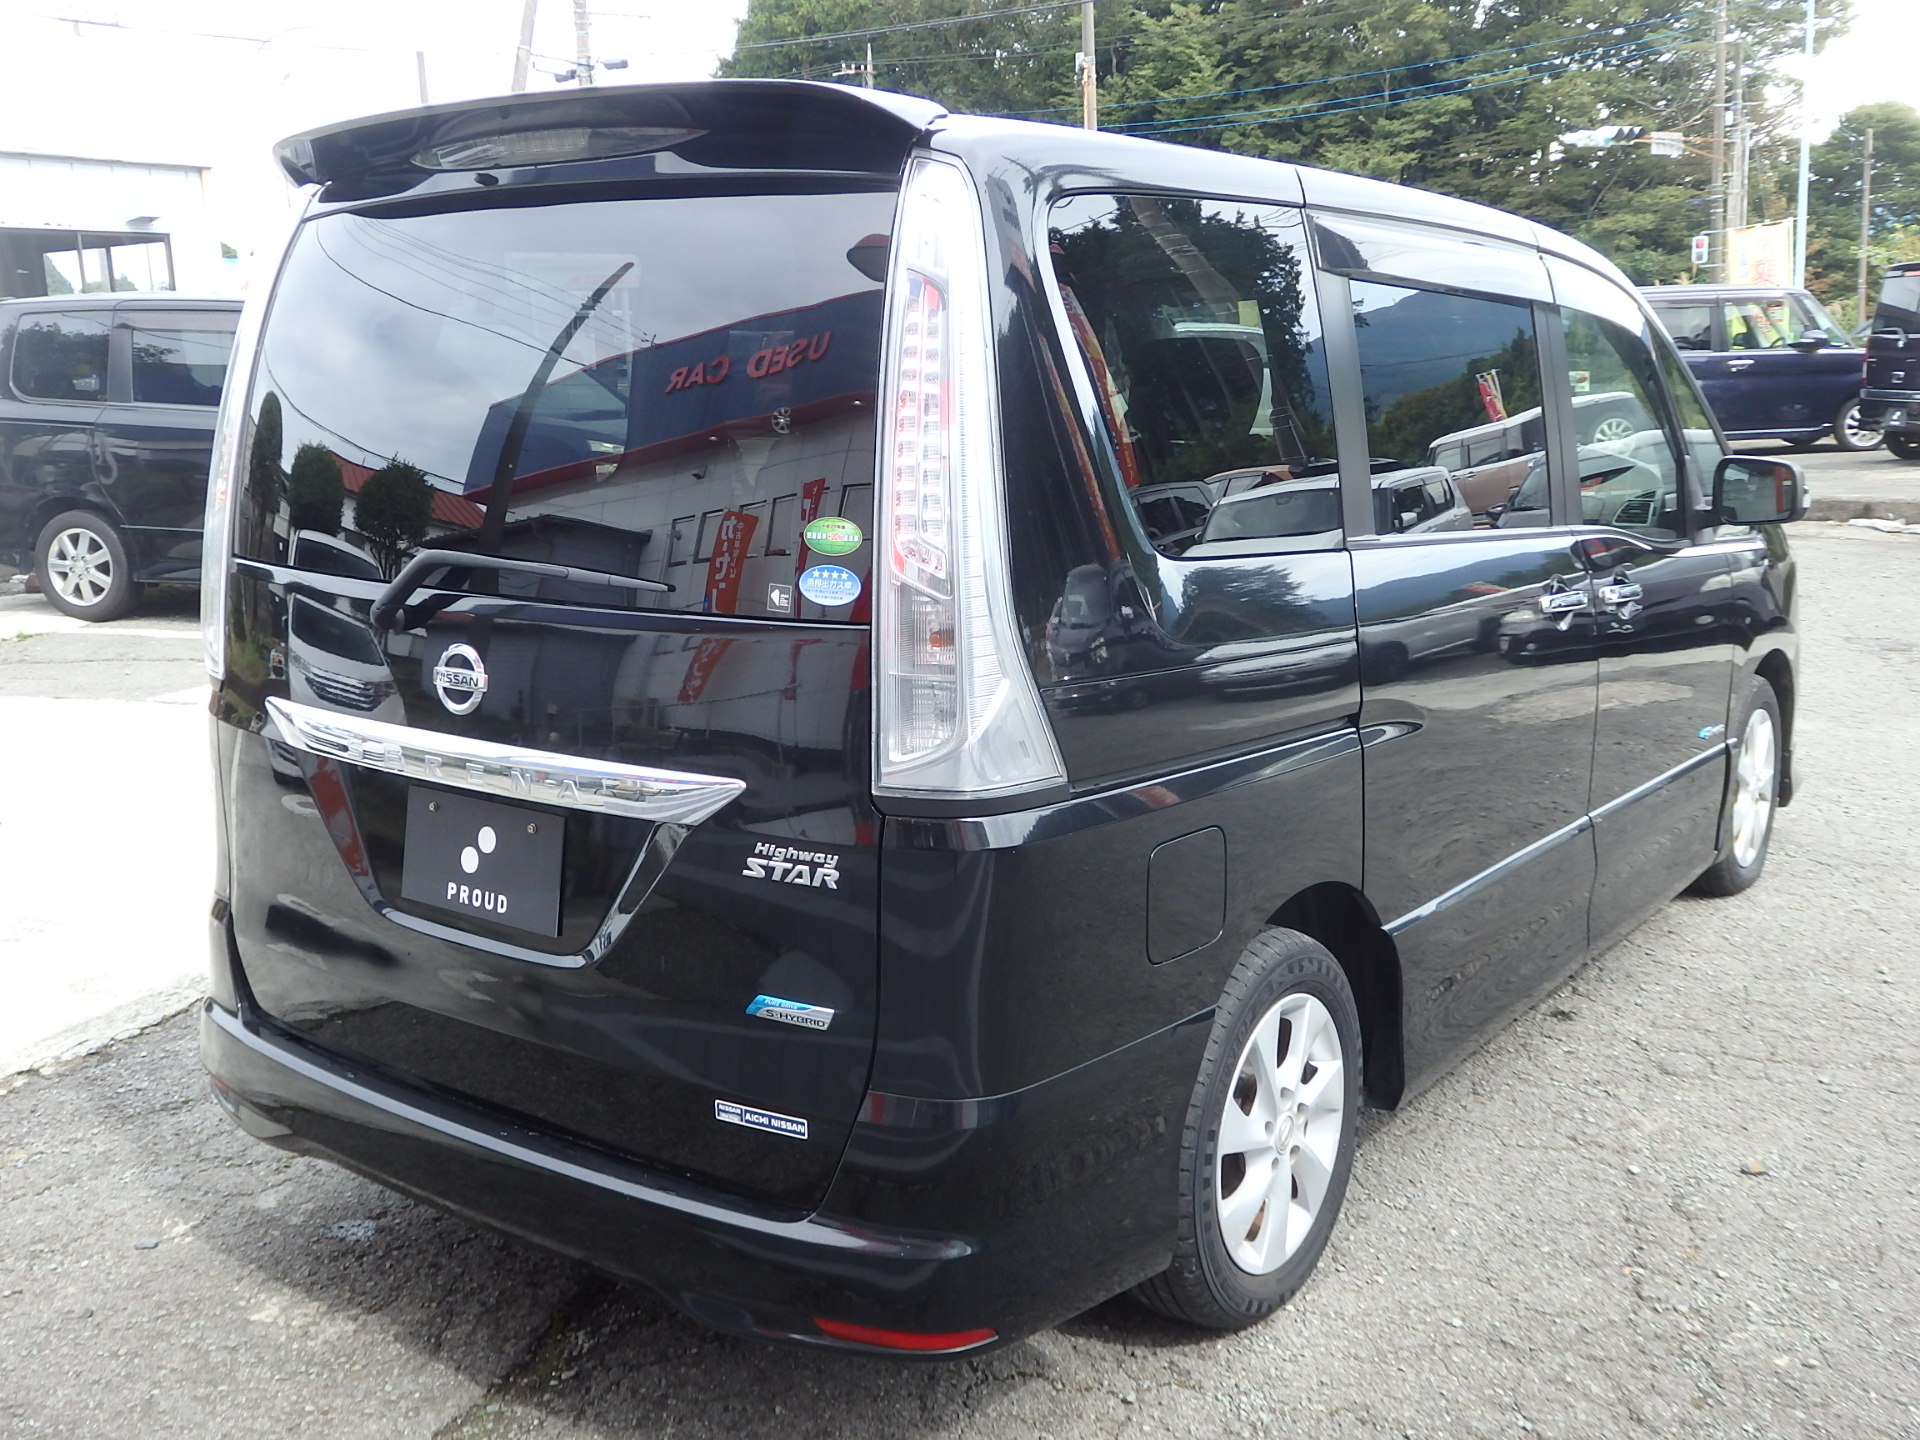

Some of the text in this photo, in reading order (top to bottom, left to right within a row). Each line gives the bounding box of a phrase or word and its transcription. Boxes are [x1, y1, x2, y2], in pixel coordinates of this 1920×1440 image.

[435, 669, 479, 688] NISSAN
[347, 739, 581, 802] SERENA
[754, 842, 839, 868] Highway
[742, 857, 840, 890] STAR
[447, 881, 508, 914] PROUD
[718, 1103, 741, 1114] NISSAN
[745, 1113, 769, 1125] AICHI
[771, 1118, 805, 1134] NISSAN
